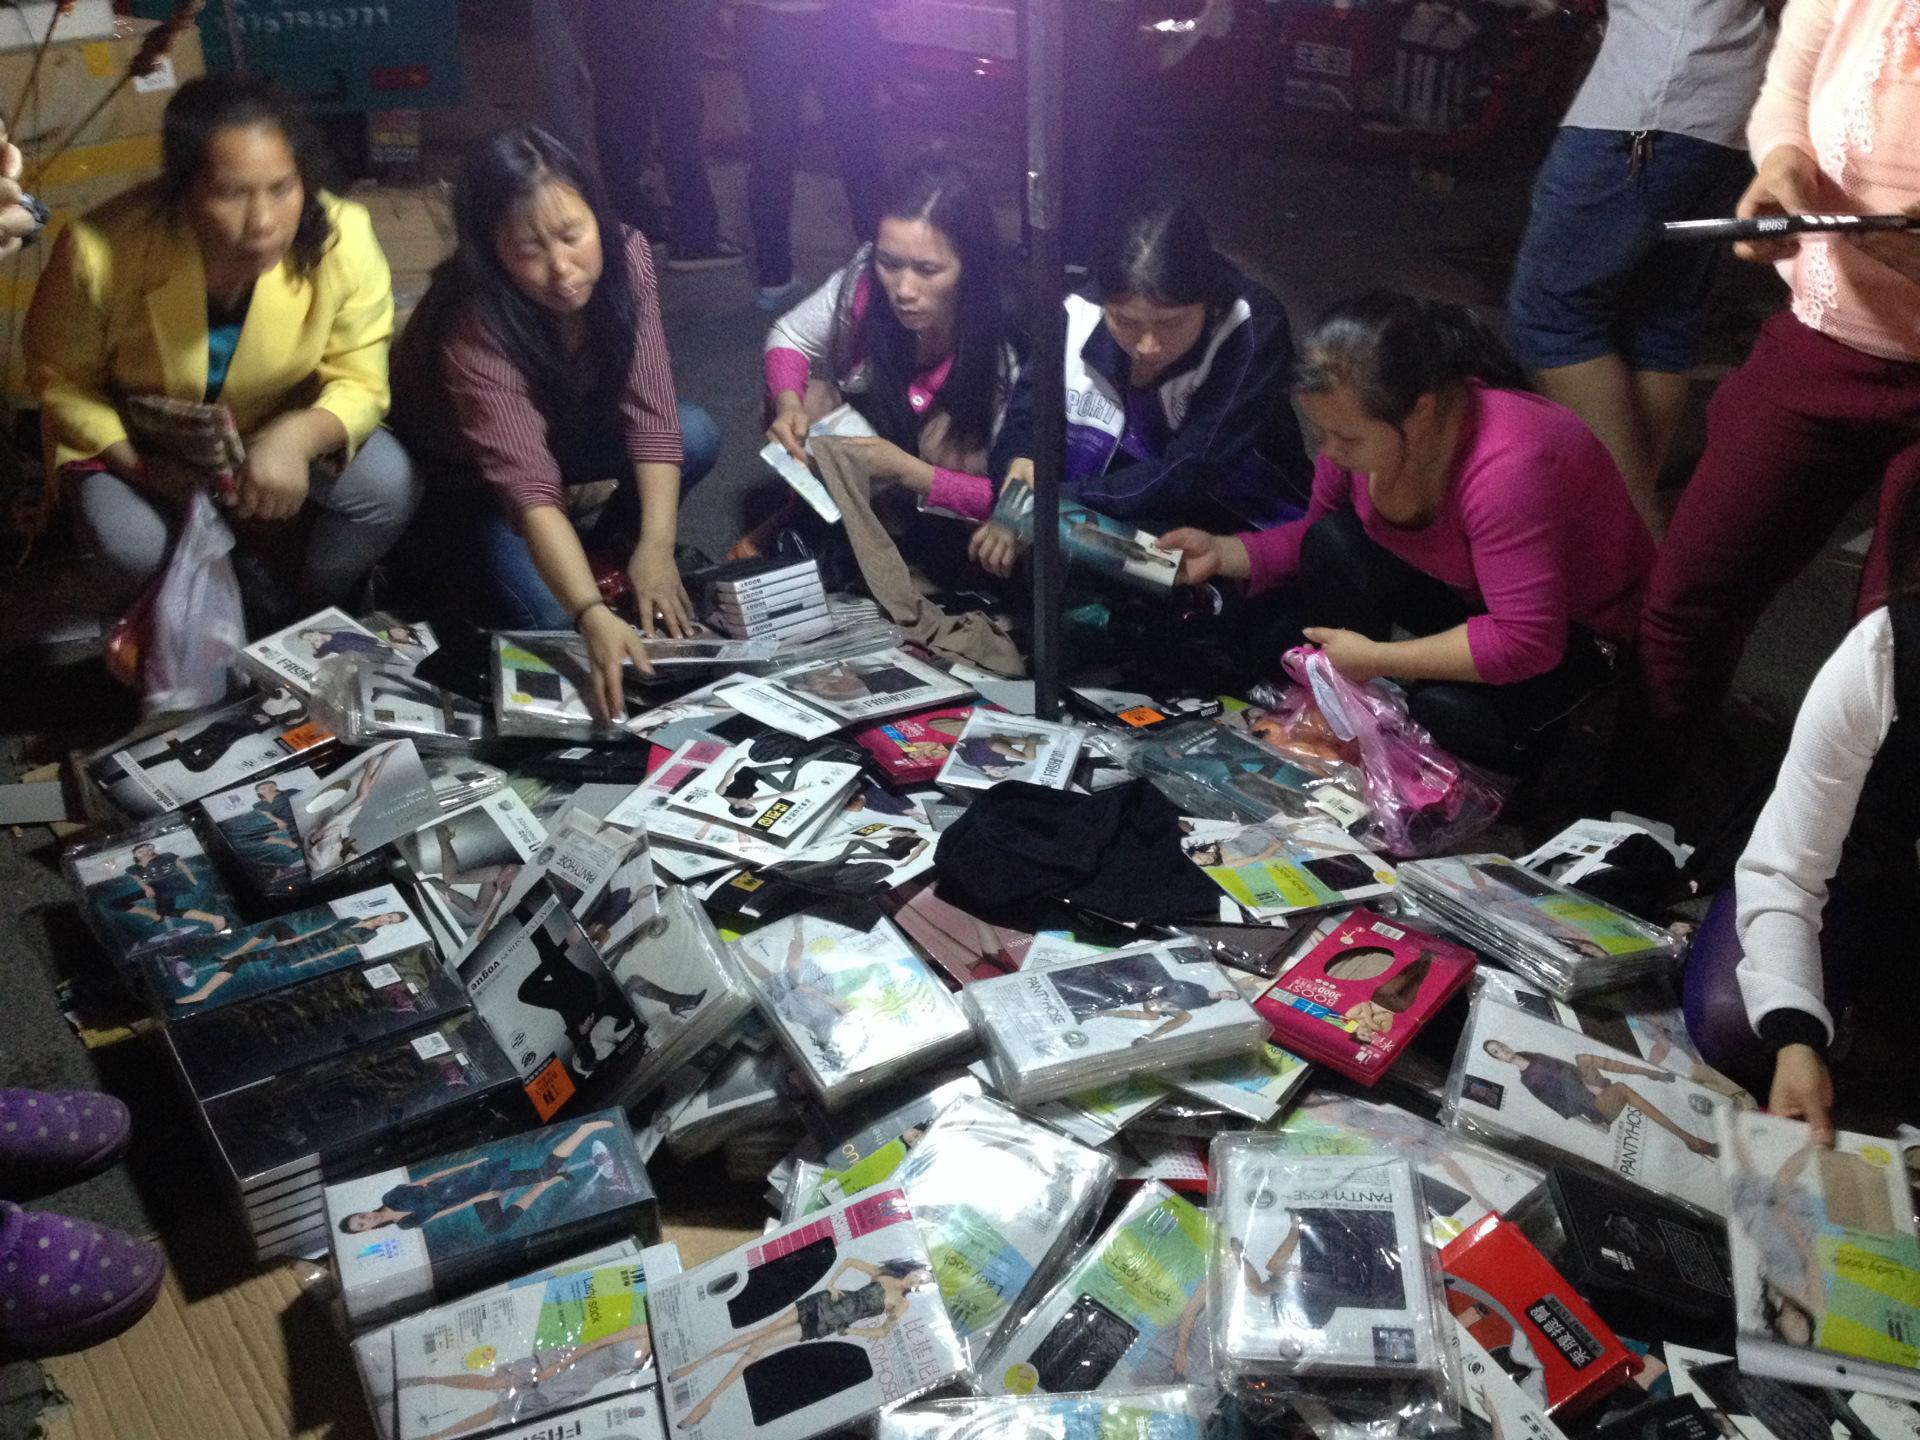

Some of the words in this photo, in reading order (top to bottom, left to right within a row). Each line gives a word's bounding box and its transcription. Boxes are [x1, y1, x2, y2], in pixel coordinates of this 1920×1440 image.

[1757, 219, 1788, 231] BOOST
[1066, 389, 1121, 425] PORT
[863, 691, 912, 707] FASHION
[1201, 706, 1218, 717] BOOST
[153, 789, 175, 807] vogue
[471, 961, 500, 990] vogue
[1025, 976, 1066, 1025] PANTYHOSE
[1286, 983, 1337, 1007] BOOST
[1620, 1106, 1642, 1176] PANTYHOS
[1295, 1190, 1393, 1204] PANTYHOSE
[584, 1276, 598, 1299] Lady
[972, 1269, 1004, 1297] Lady
[1112, 1255, 1143, 1282] Lady
[1142, 1281, 1172, 1306] sock
[587, 1300, 603, 1325] sock
[863, 1319, 901, 1401] PNTYHOSE
[903, 1317, 941, 1381] 比基尼
